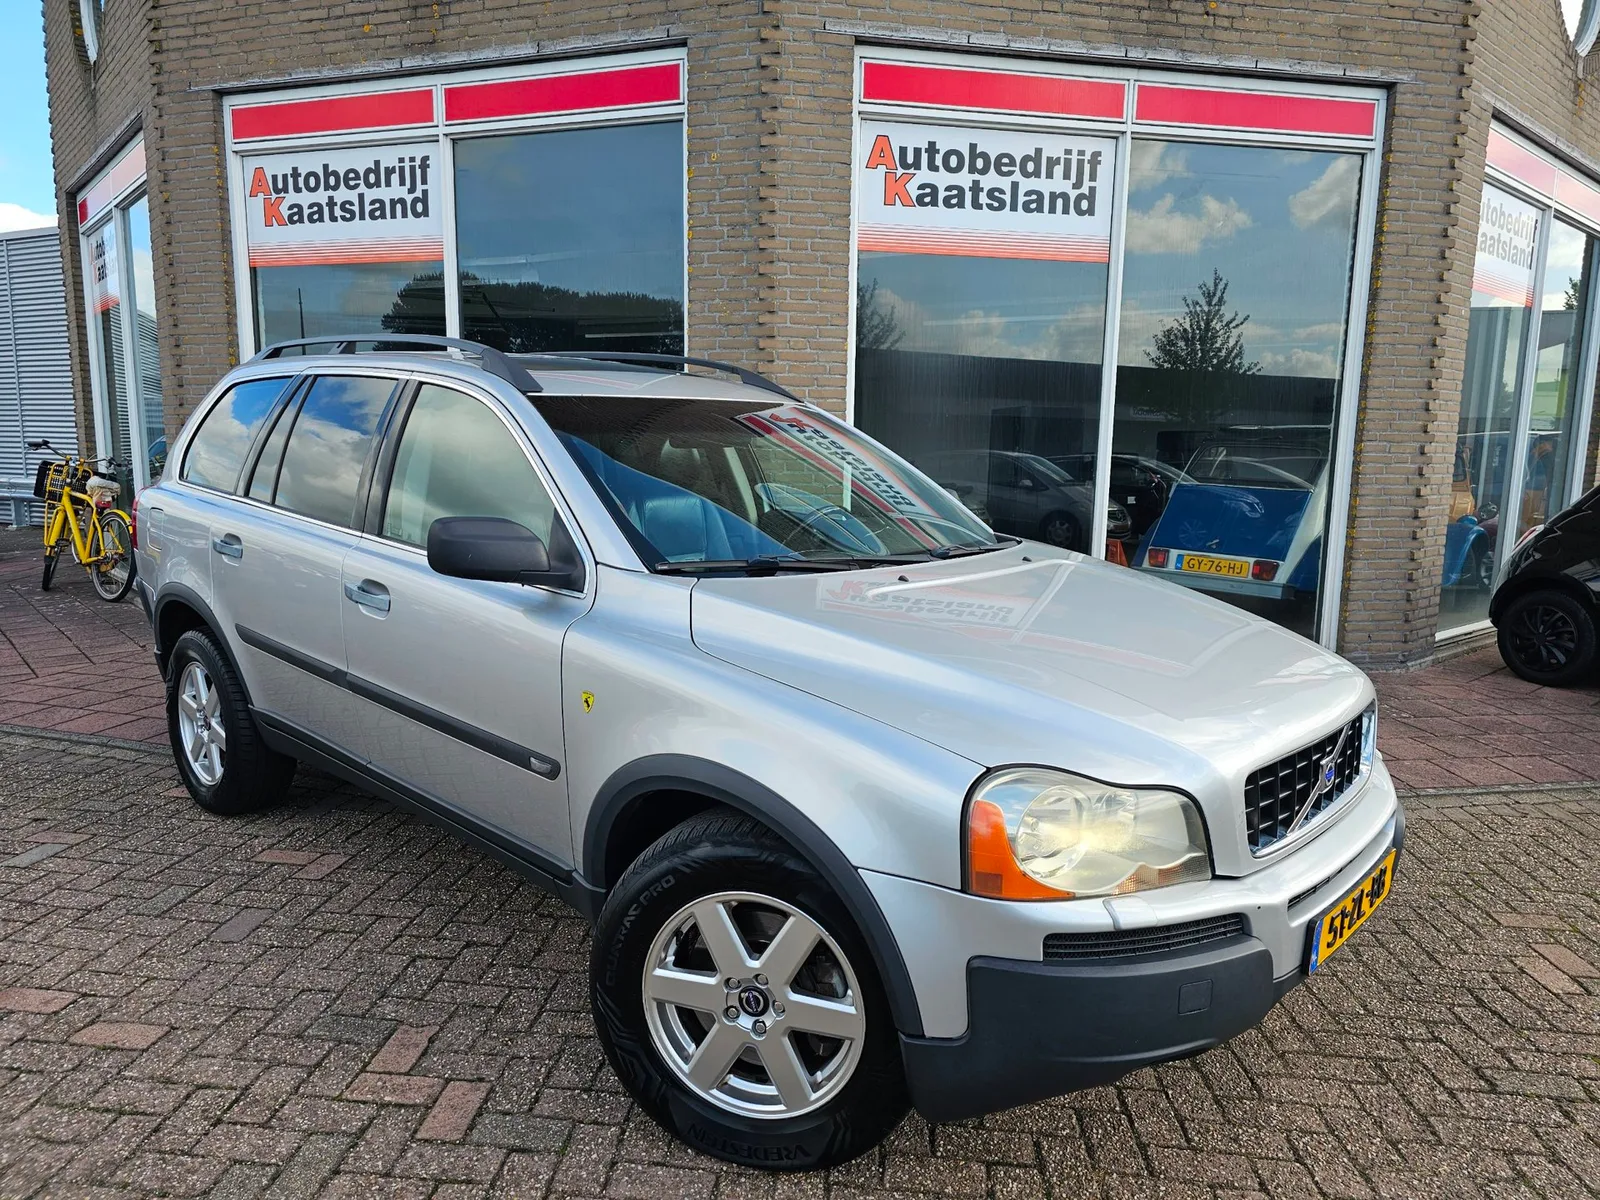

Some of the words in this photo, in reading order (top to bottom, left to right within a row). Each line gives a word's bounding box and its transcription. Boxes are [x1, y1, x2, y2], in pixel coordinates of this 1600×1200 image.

[249, 155, 431, 198] Autobedrijf
[866, 135, 1103, 190] Autobedrijf
[263, 189, 430, 227] Kaatsland
[884, 171, 1097, 217] Kaatsland
[1480, 198, 1538, 249] utobedrijf
[1477, 231, 1534, 270] aatsland
[1187, 557, 1244, 575] GY-76-HJ
[639, 874, 676, 907] PRO
[686, 1123, 813, 1162] VREDESTEIN
